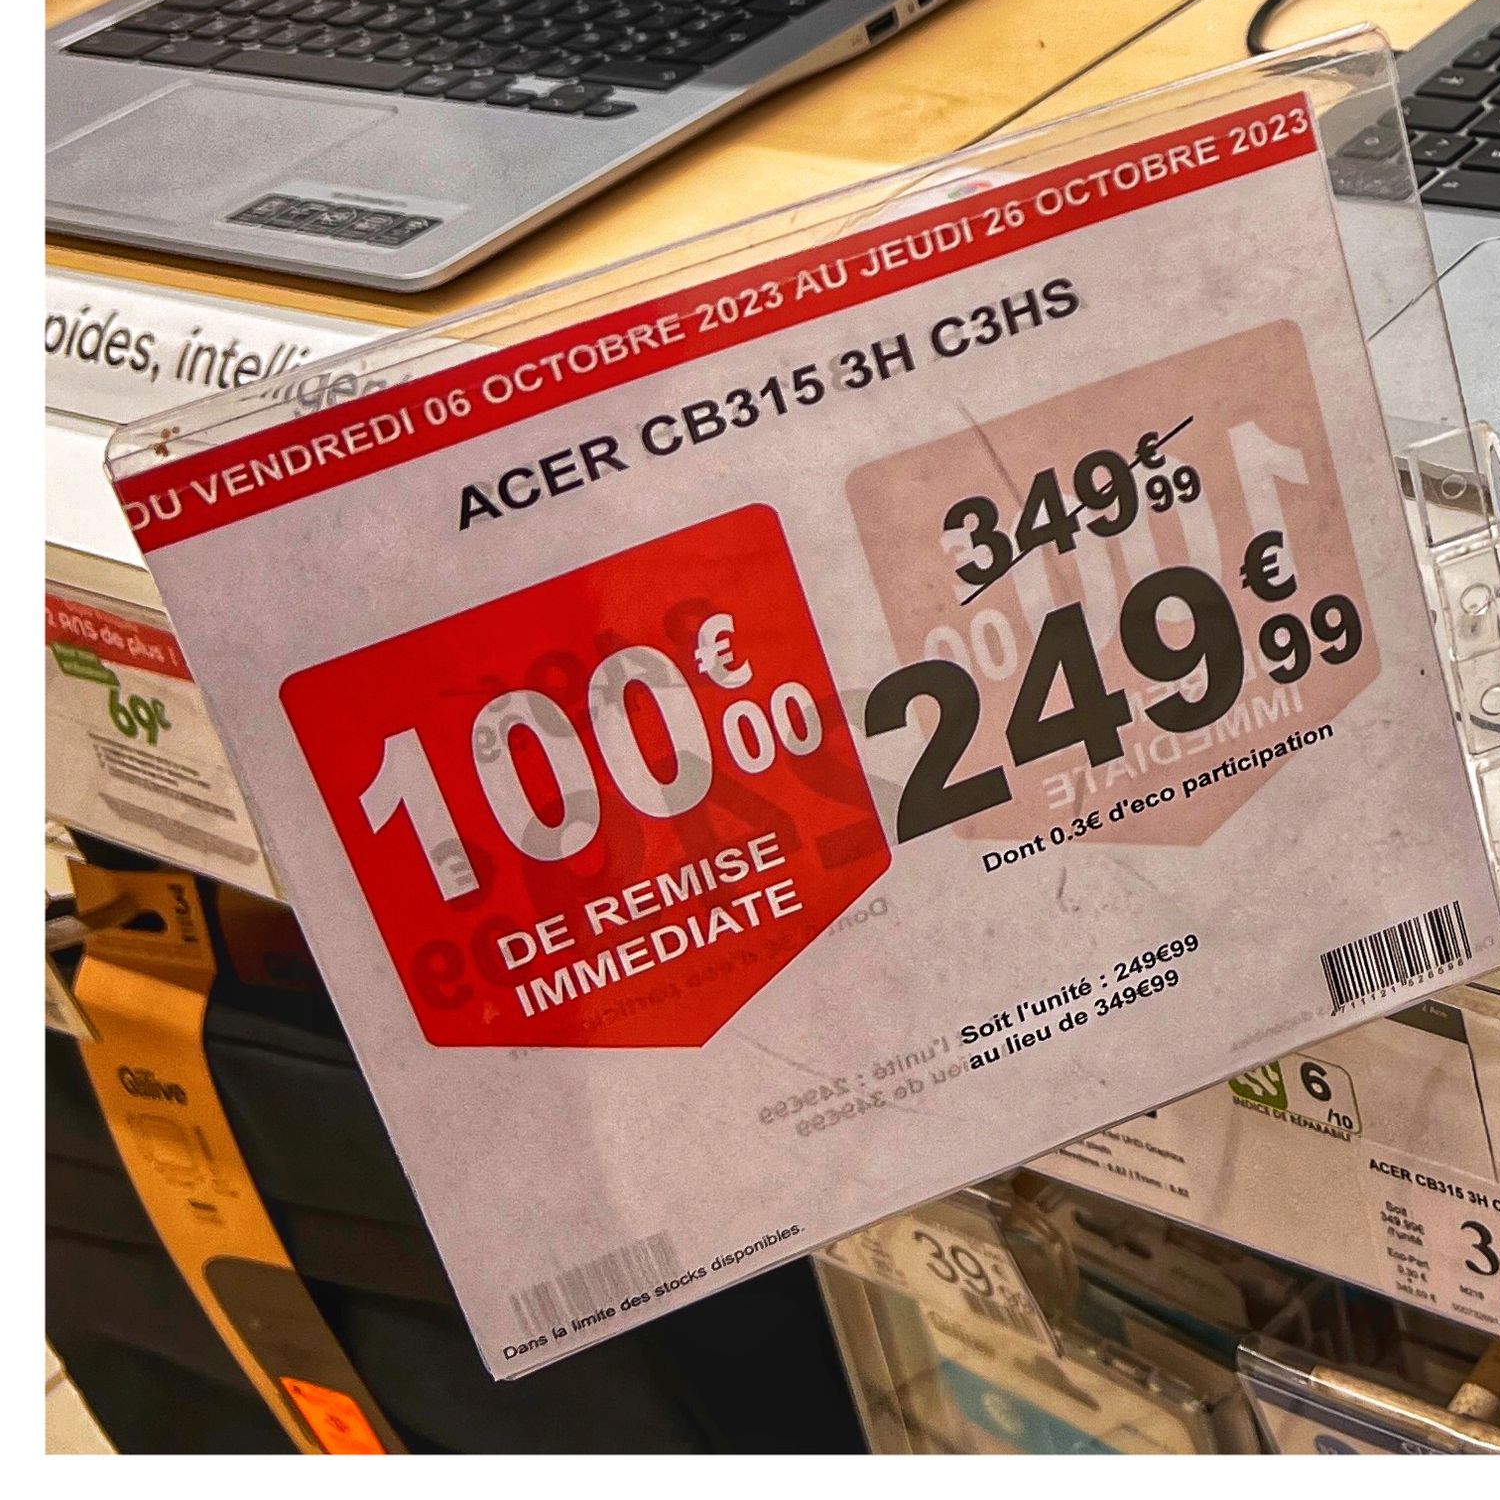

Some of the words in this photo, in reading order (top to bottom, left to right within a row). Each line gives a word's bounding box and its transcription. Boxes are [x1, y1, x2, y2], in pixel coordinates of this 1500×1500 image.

[189, 408, 418, 506] VENDREDI
[422, 386, 474, 428] 06
[480, 311, 686, 408] OCTOBRE
[695, 281, 787, 340] 2023
[792, 257, 850, 301] AU
[858, 215, 977, 281] JEUDI
[980, 194, 1029, 241] 26
[1032, 137, 1222, 222] OCTOBRE
[1227, 107, 1311, 157] 2023
[455, 432, 632, 533] ACER
[639, 363, 828, 459] CB315
[839, 329, 917, 392] 3H
[927, 276, 1084, 360] C3HS
[980, 833, 1047, 875] Dont
[1049, 809, 1104, 847] 0.3€
[1108, 786, 1176, 824] d'eco
[1180, 722, 1335, 799] participation
[495, 913, 576, 972] DE
[583, 832, 787, 938] REMISE
[514, 878, 804, 1018] IMMEDIATE
[959, 1008, 1014, 1047] Soit
[1016, 975, 1094, 1025] l'unité
[1112, 933, 1200, 984] 249€99
[967, 1046, 1002, 1072] au
[1004, 1025, 1054, 1058] lieu
[1057, 1008, 1091, 1035] de
[1094, 968, 1181, 1019] 349€99
[1299, 1060, 1332, 1102] 6
[1369, 1158, 1413, 1184] ACER
[1415, 1171, 1465, 1200] CB315
[1467, 1189, 1490, 1209] 3H
[502, 1332, 549, 1361] Dans
[551, 1324, 568, 1341] la
[570, 1304, 617, 1333] limite
[619, 1290, 652, 1313] des
[653, 1266, 708, 1299] stocks
[710, 1222, 806, 1273] disponibles.
